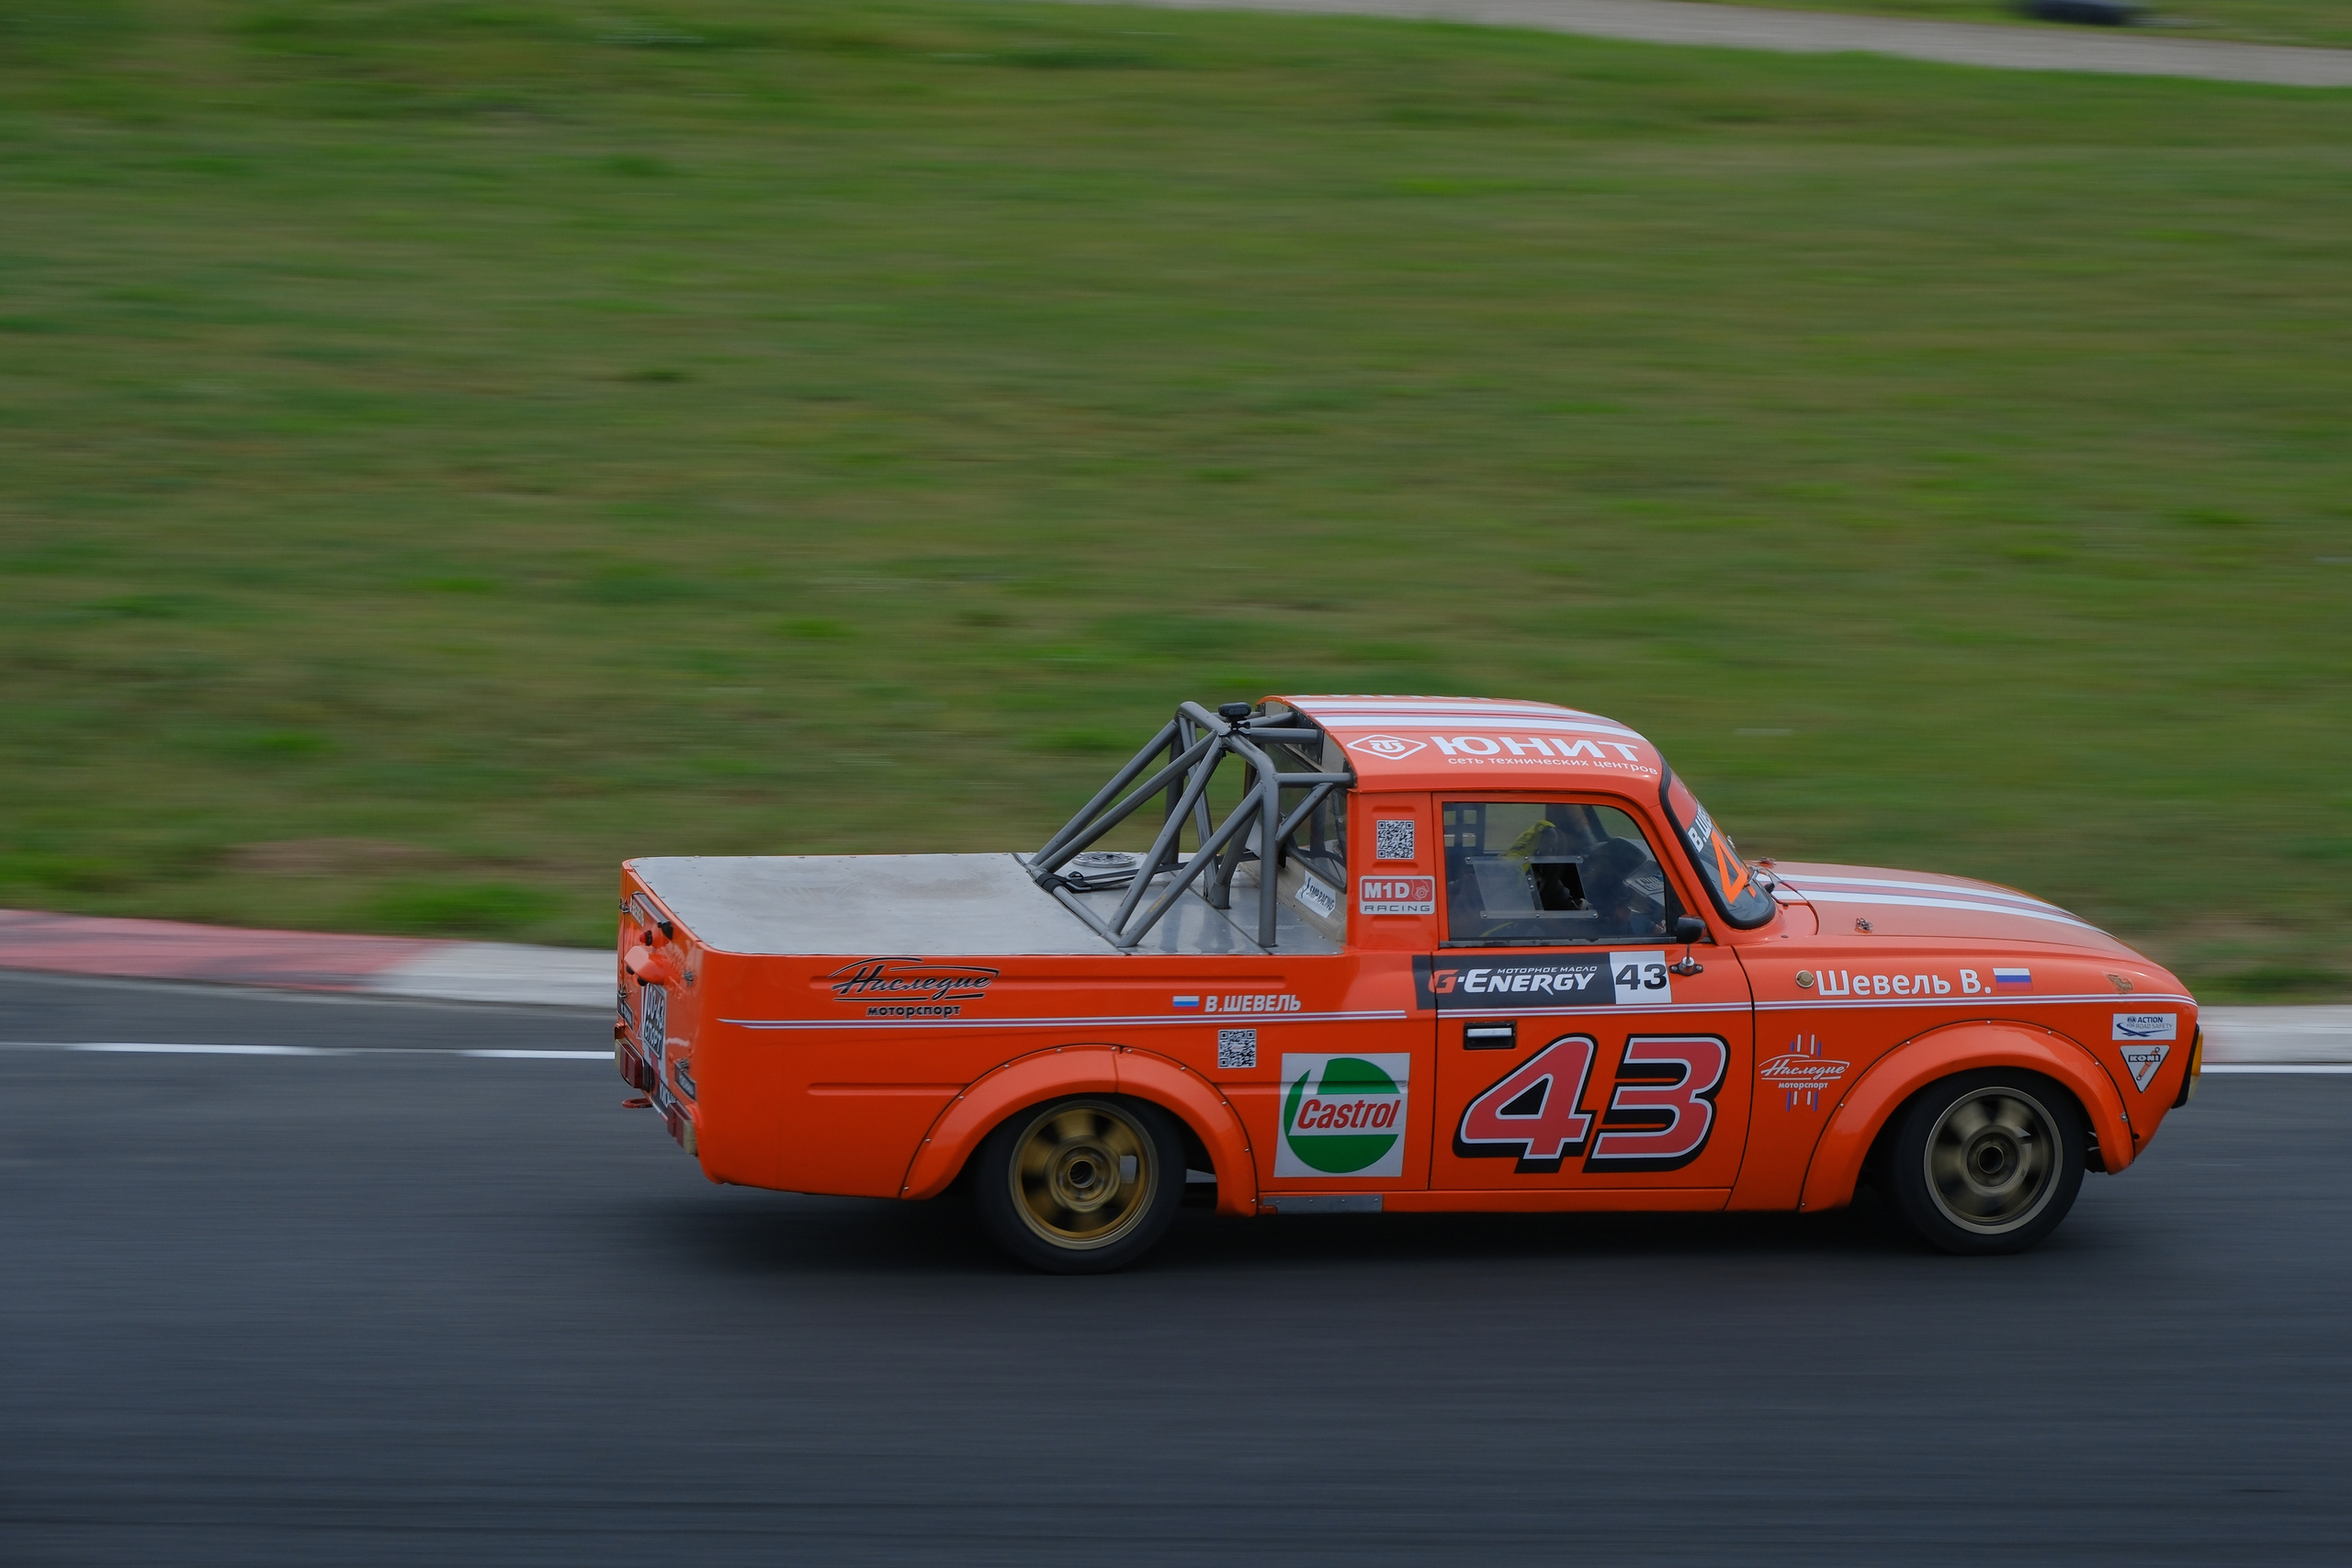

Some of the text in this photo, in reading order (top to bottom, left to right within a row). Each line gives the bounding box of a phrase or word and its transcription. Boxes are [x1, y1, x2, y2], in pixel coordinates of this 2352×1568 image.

[1430, 736, 1638, 761] ЮНИТ
[1448, 757, 1658, 775] сеть технических центров
[1364, 882, 1410, 899] M1D
[831, 964, 992, 1001] Наследие
[1615, 964, 1668, 990] 43
[1815, 969, 1992, 996] Шевель В.
[866, 1005, 961, 1019] моторспорт
[1204, 995, 1302, 1012] В.ШЕВЕЛЬ
[1760, 1058, 1846, 1080] Наследие
[1778, 1082, 1828, 1090] моторспорт
[1297, 1099, 1402, 1130] Castrol
[1452, 1032, 1731, 1174] 43
